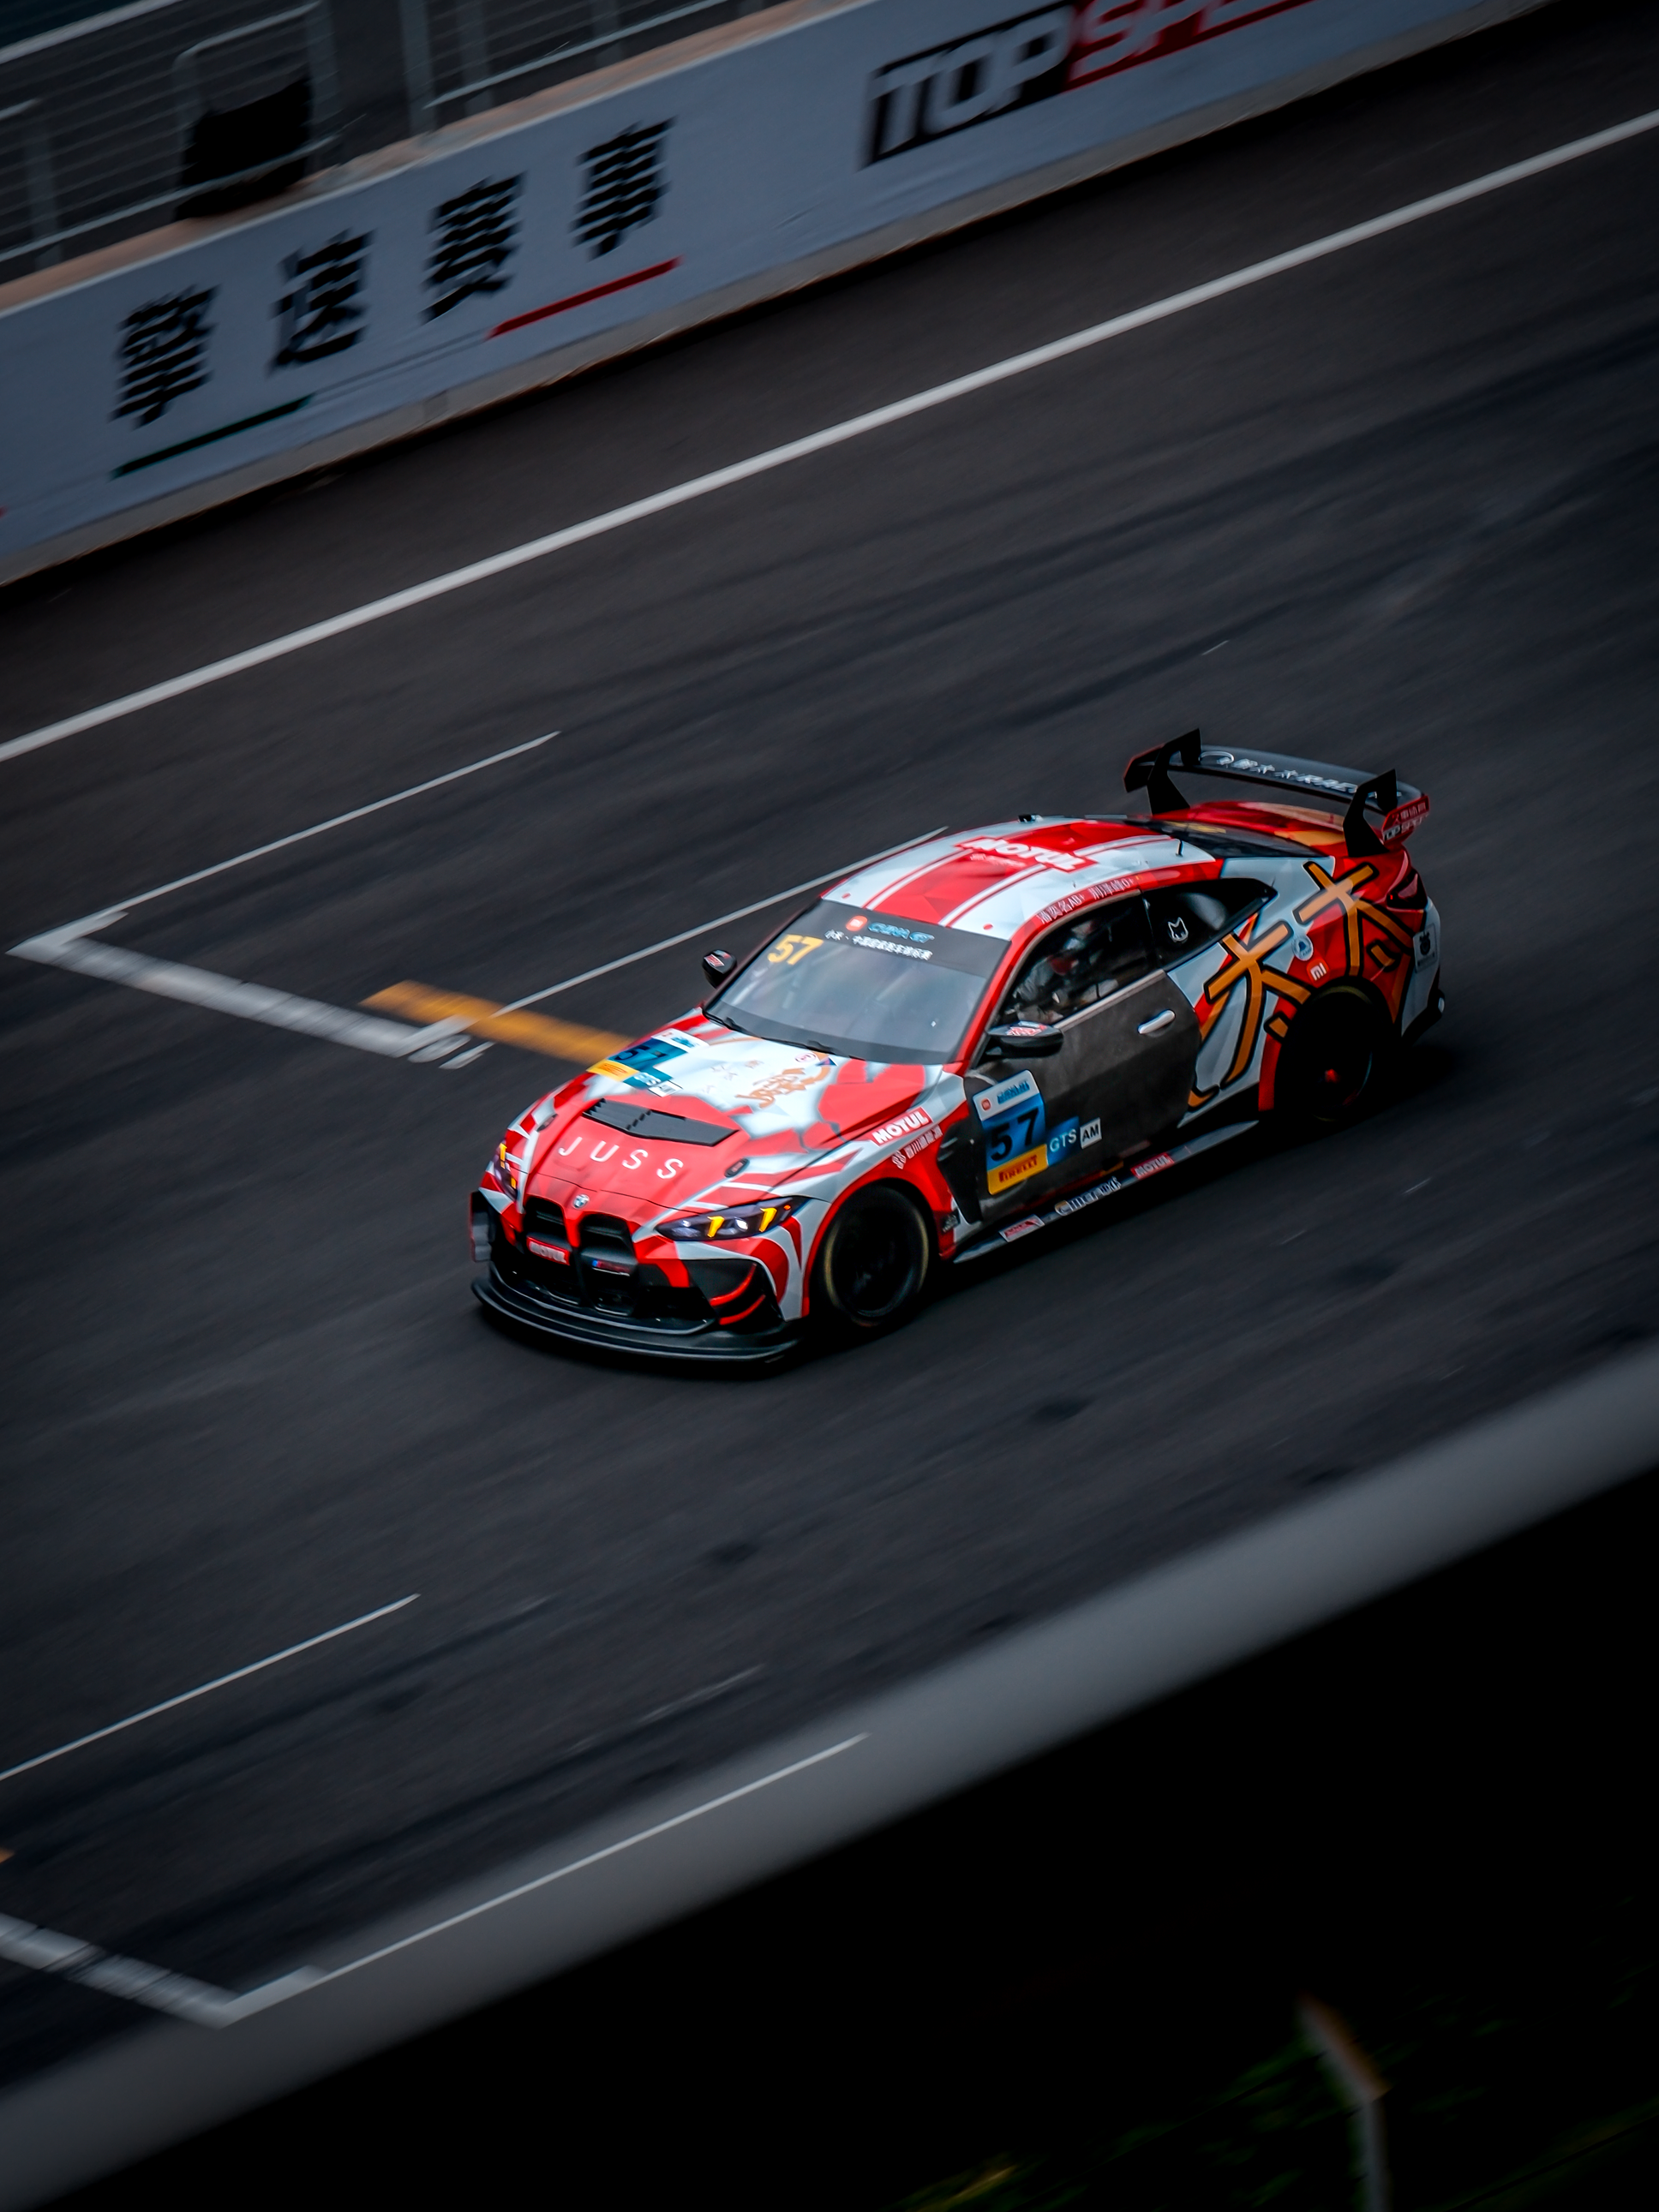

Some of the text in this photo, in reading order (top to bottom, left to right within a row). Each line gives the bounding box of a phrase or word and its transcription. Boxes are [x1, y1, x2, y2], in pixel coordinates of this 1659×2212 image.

[967, 836, 1087, 872] MOTUL
[768, 934, 824, 966] 57
[871, 1110, 930, 1145] MOTUL
[990, 1106, 1038, 1163] 57
[1049, 1125, 1099, 1154] GTS AM
[558, 1136, 684, 1180] JUSS
[1135, 1155, 1171, 1178] MOTUL
